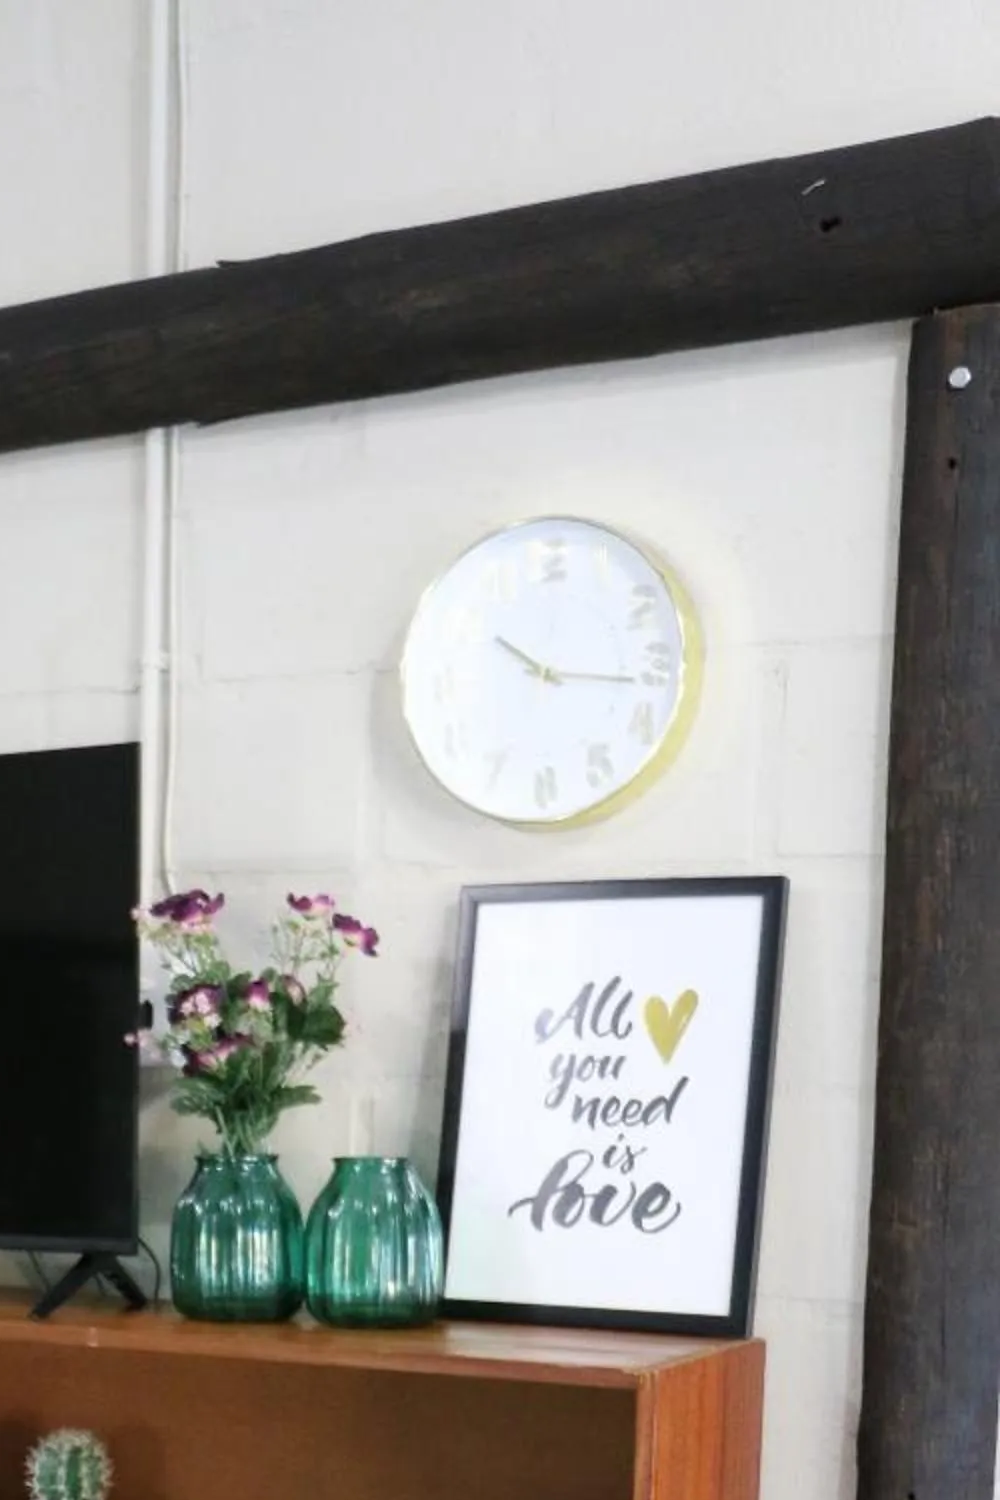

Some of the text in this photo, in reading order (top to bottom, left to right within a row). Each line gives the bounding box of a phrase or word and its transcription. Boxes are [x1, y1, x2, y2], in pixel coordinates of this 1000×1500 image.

[535, 976, 633, 1044] All
[544, 1052, 627, 1109] you
[572, 1077, 688, 1129] need
[602, 1134, 648, 1174] is
[508, 1150, 681, 1233] love
